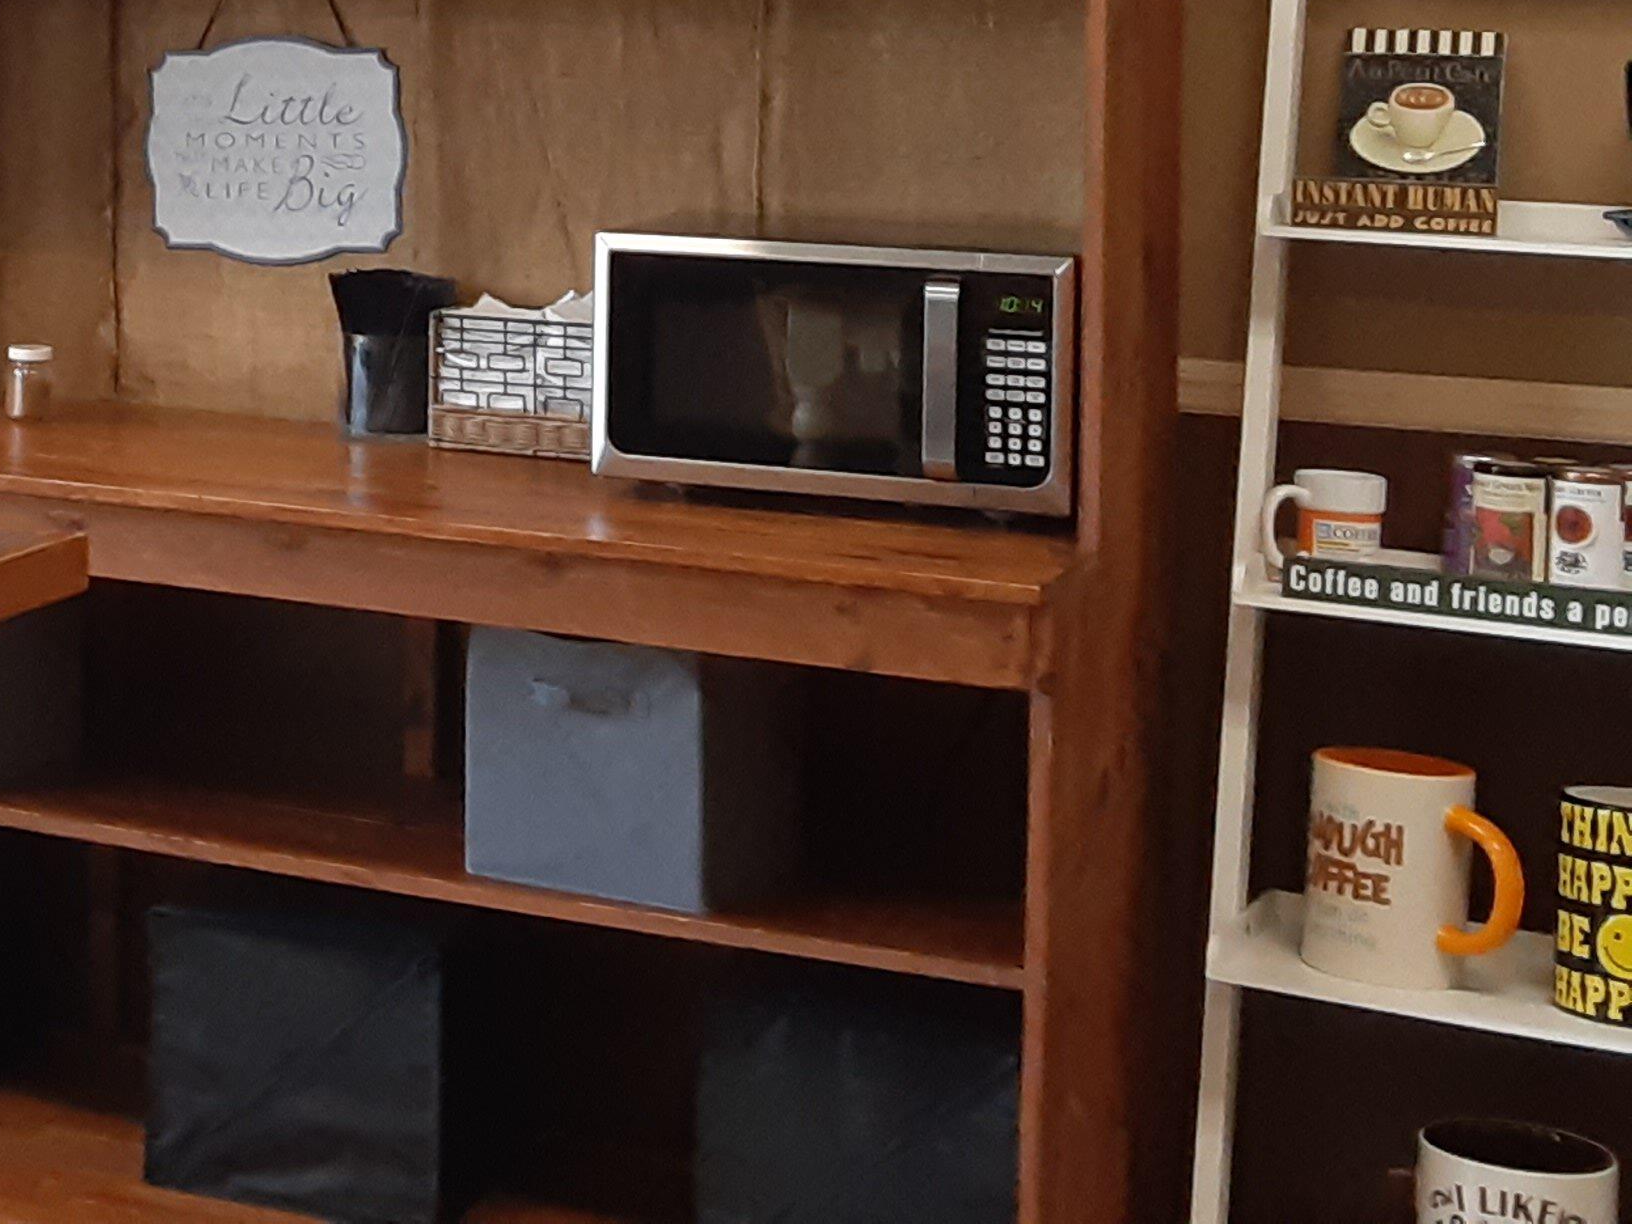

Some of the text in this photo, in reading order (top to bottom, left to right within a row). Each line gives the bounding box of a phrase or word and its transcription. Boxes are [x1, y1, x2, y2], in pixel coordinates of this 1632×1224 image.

[221, 74, 365, 126] Little
[186, 132, 366, 150] MOMENTS
[211, 156, 280, 173] MAKE
[206, 155, 368, 226] LIFE Big
[1293, 179, 1495, 213] INSTANT HUMAN
[1294, 210, 1494, 234] JUST ADD COFFEE
[1288, 564, 1380, 600] Coffee
[1389, 579, 1439, 608] and
[1450, 582, 1556, 621] friends
[1567, 601, 1583, 623] a
[1556, 909, 1590, 959] BE
